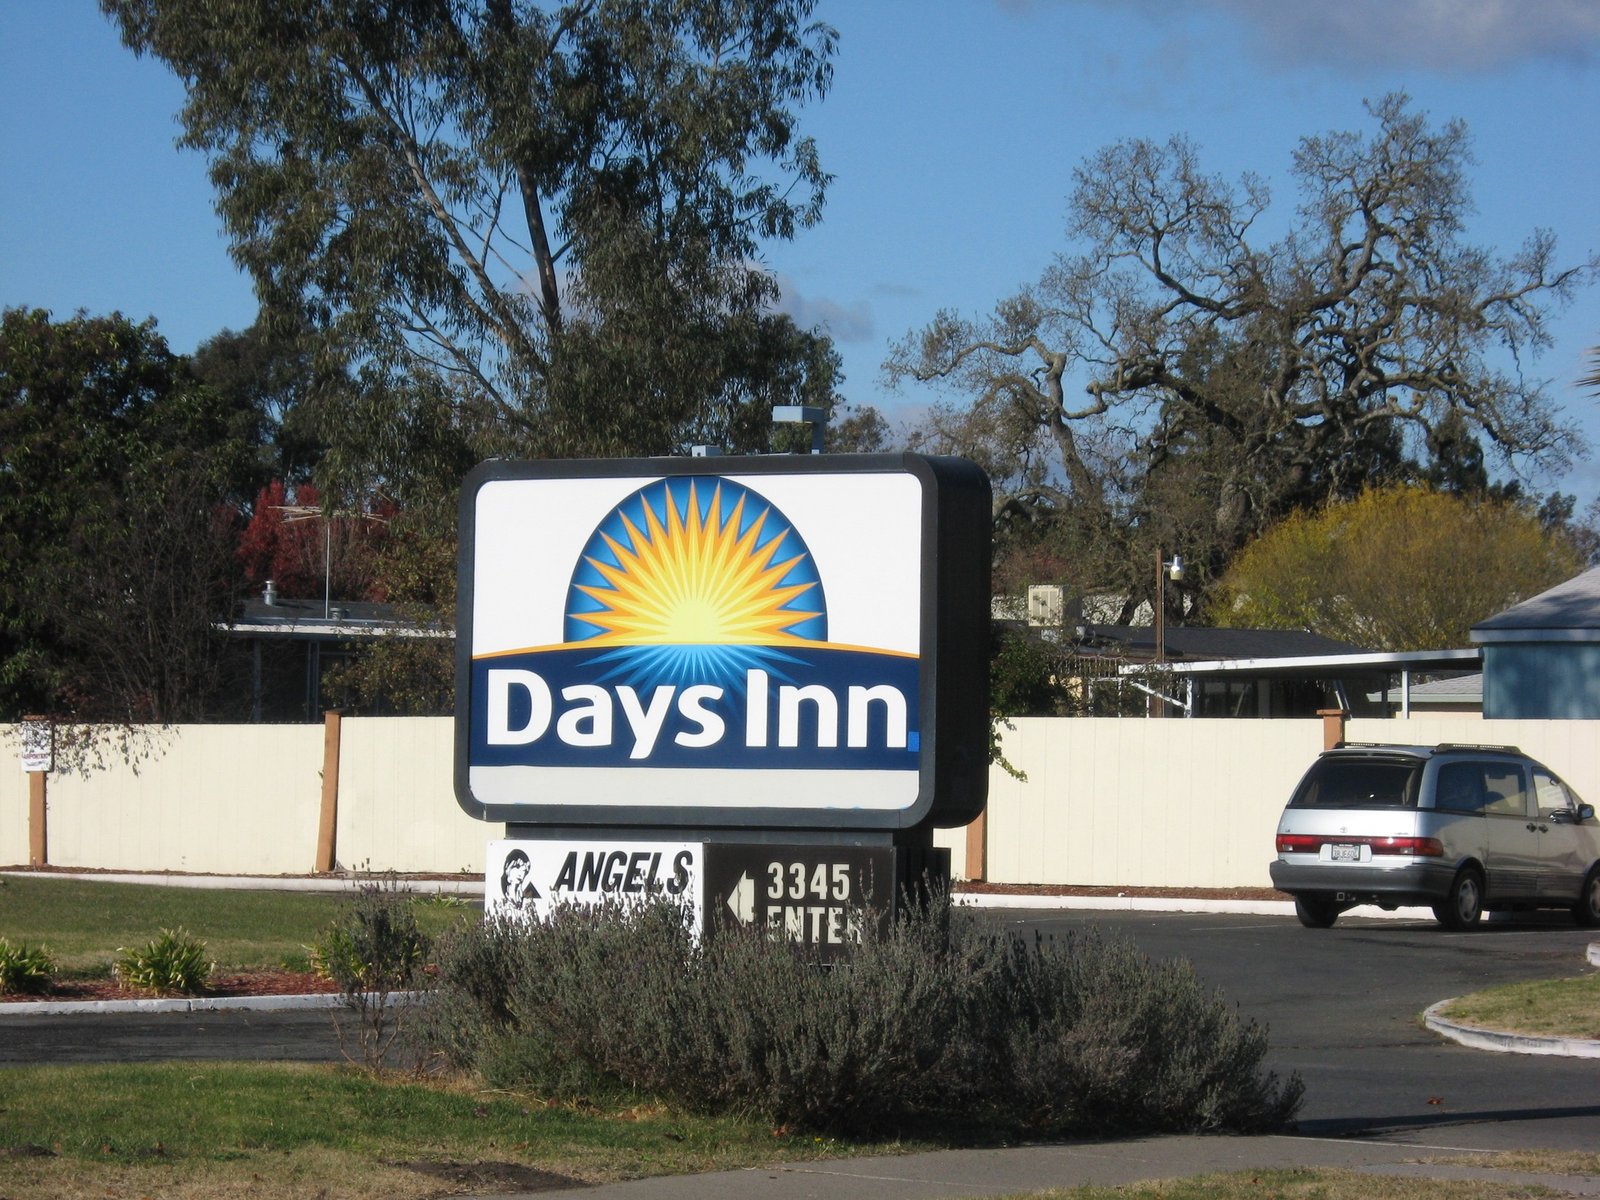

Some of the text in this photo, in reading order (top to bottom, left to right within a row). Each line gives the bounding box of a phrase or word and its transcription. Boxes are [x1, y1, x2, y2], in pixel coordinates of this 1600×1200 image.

[487, 669, 907, 759] Days Inn
[551, 850, 693, 894] ANGELS
[767, 862, 850, 900] 3345
